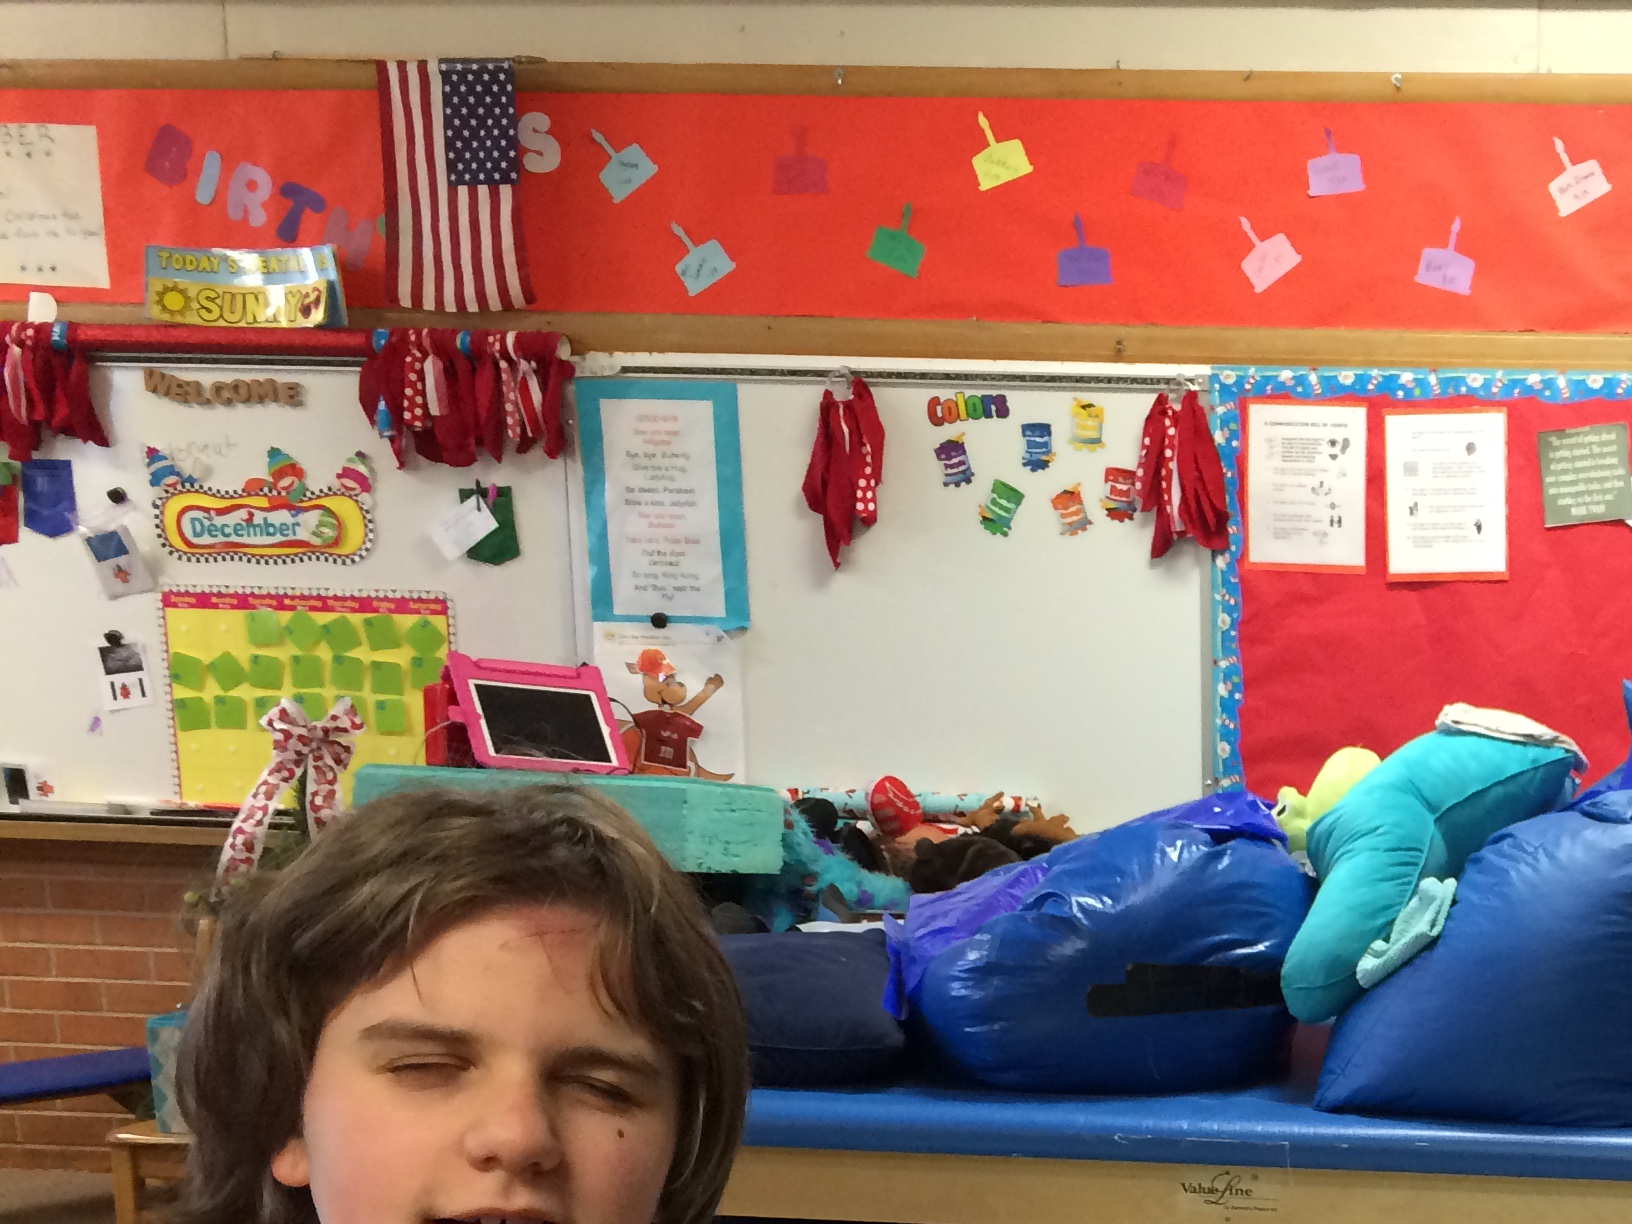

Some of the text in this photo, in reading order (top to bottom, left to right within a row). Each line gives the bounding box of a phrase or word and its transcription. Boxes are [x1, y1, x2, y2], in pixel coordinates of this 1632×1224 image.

[144, 123, 386, 271] BIRTH
[157, 250, 238, 273] TODAY'S
[143, 367, 303, 406] WELCOME
[927, 391, 1011, 427] Colors
[189, 516, 301, 539] December
